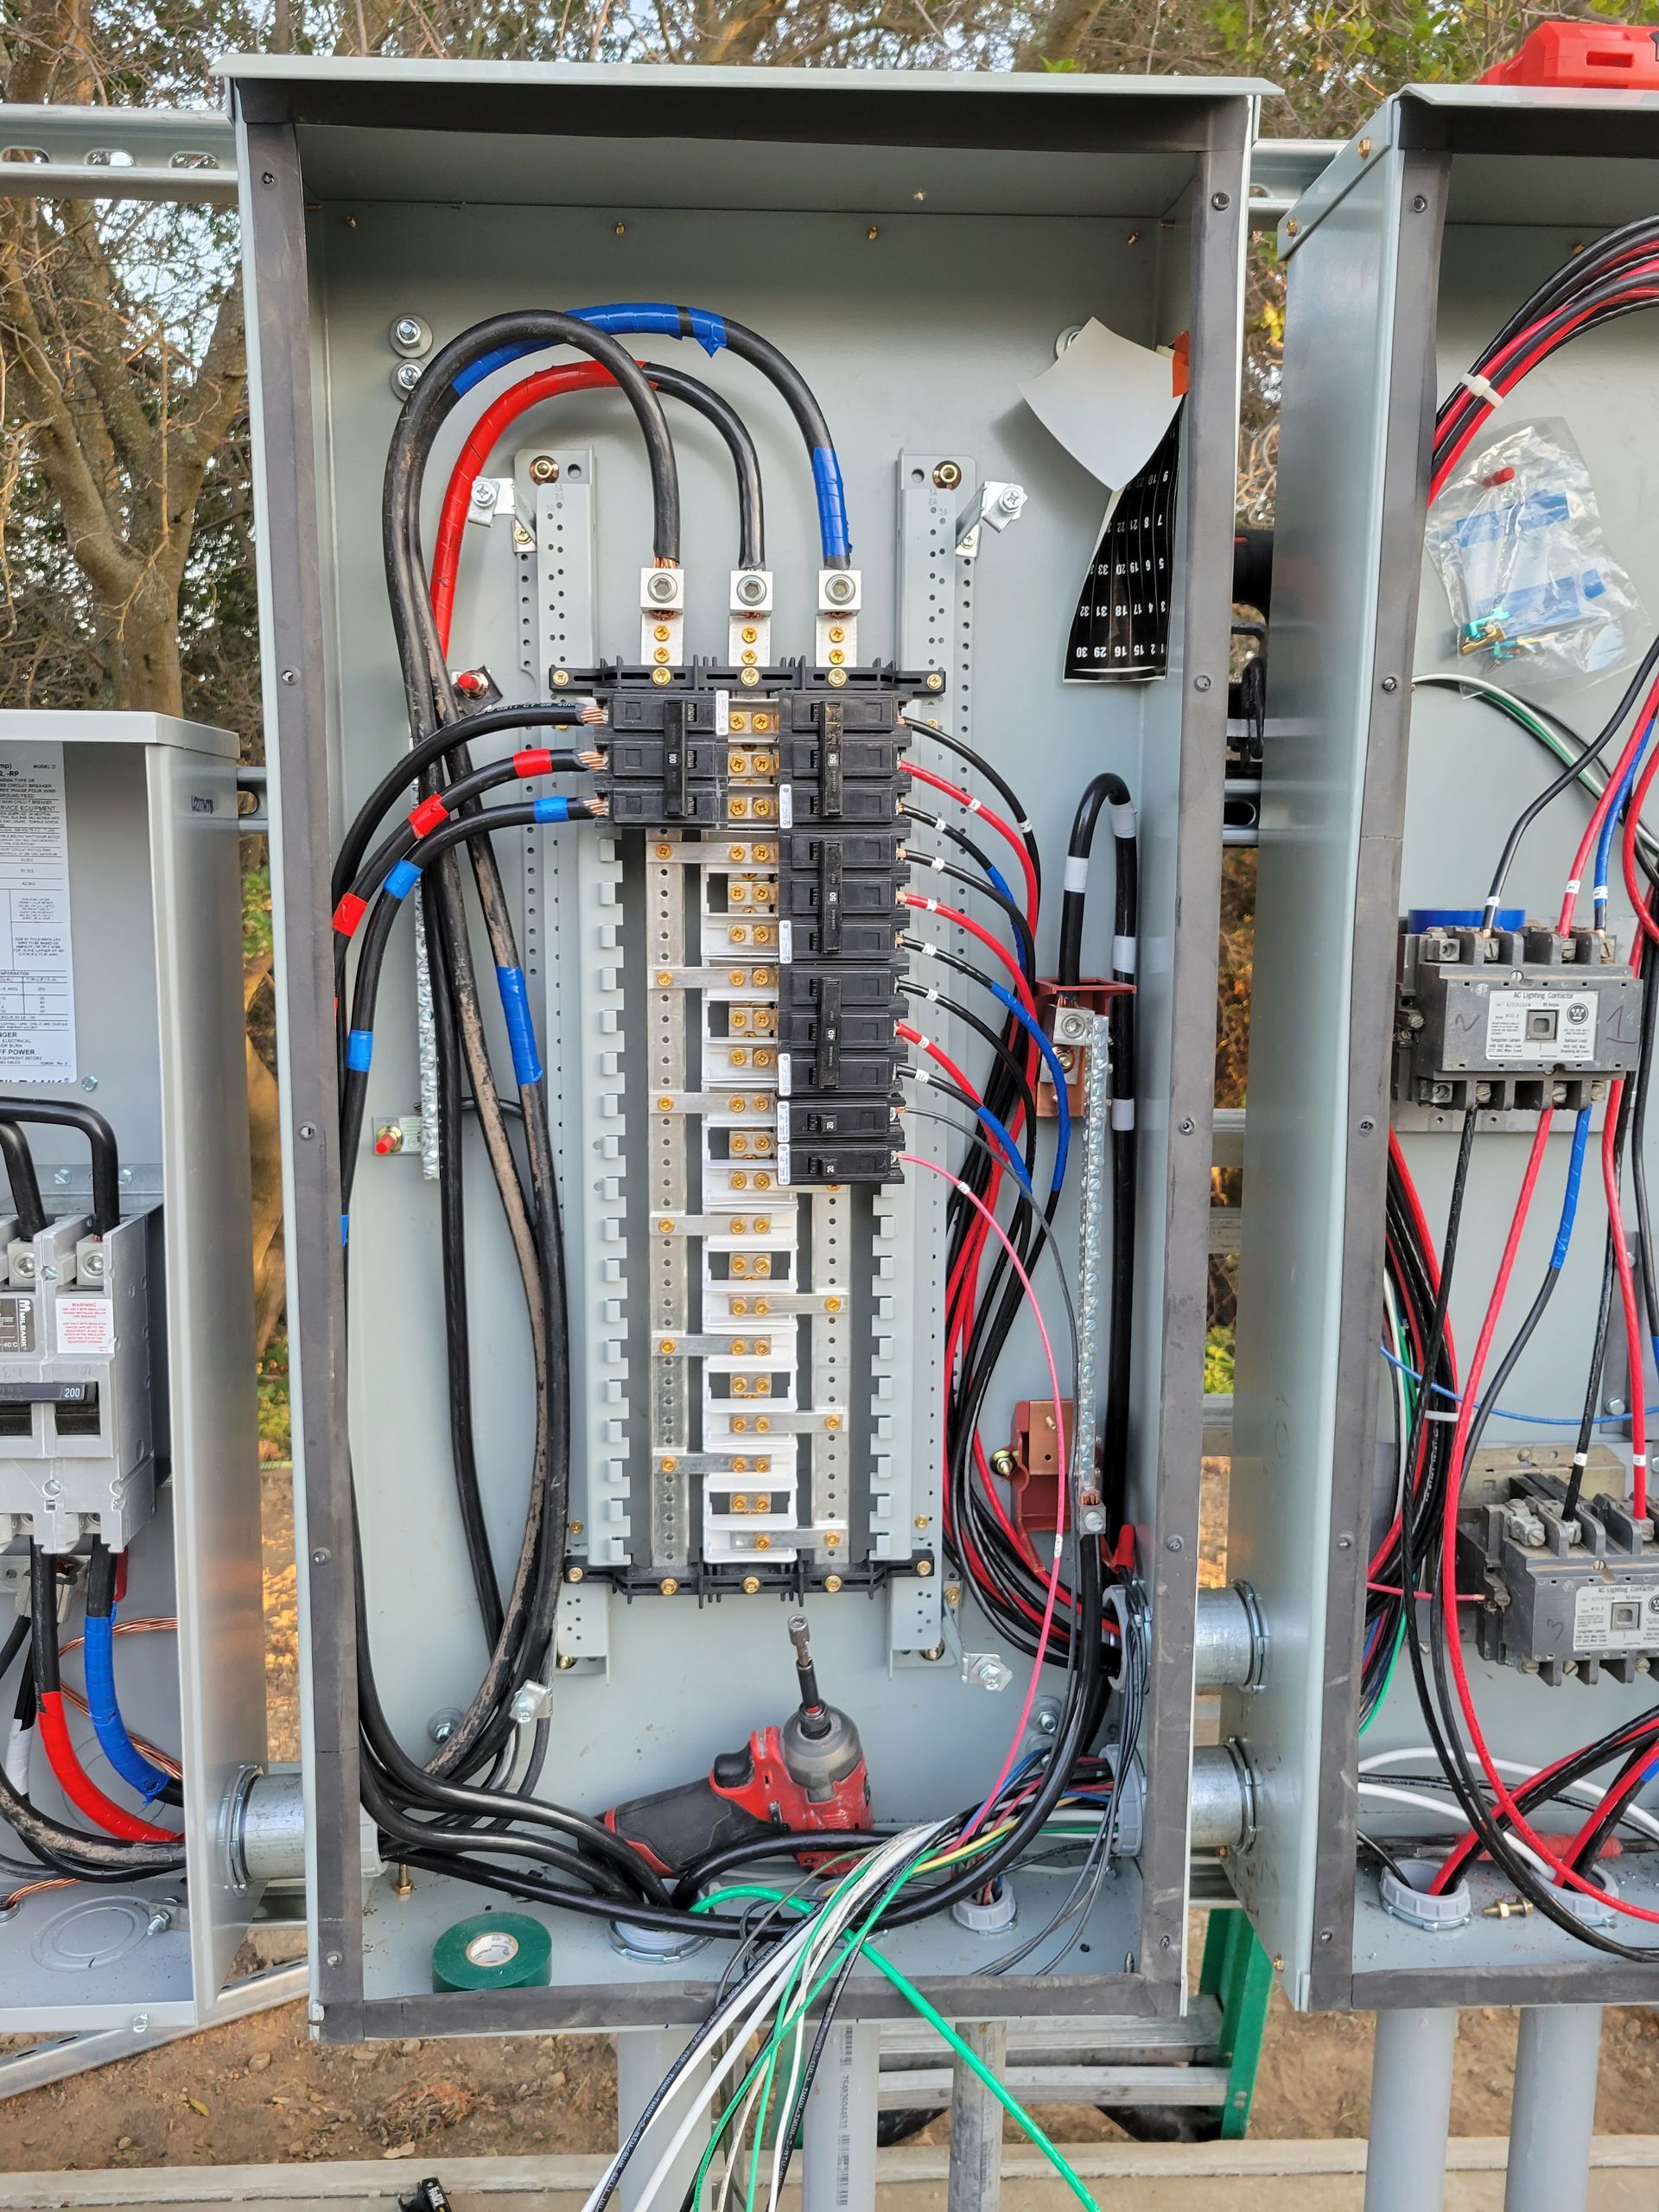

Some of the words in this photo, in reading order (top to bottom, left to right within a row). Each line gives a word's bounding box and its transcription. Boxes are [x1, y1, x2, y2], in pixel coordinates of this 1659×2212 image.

[1148, 474, 1157, 486] 10
[1130, 519, 1138, 531] 21
[1144, 517, 1149, 528] 8
[1157, 514, 1163, 526] 7
[1117, 521, 1125, 533] 22
[1098, 564, 1108, 575] 33
[1116, 564, 1126, 575] 20
[1130, 561, 1139, 573] 19
[1145, 559, 1151, 571] 6
[1159, 558, 1164, 570] 5
[1080, 606, 1089, 617] 32
[1096, 606, 1107, 617] 31
[1115, 605, 1128, 617] 18
[1133, 604, 1143, 615] 17
[1148, 602, 1154, 614] 4
[1161, 601, 1166, 612] 3
[1076, 647, 1088, 658] 30
[1094, 646, 1107, 658] 29
[1114, 646, 1127, 657] 16
[1134, 644, 1145, 656] 15
[1150, 644, 1156, 655] 2
[1160, 643, 1164, 654] 1
[829, 754, 836, 764] 50
[829, 892, 836, 901] 50
[827, 1030, 835, 1039] 40
[65, 1388, 80, 1397] 200
[675, 2050, 690, 2069] (UL)
